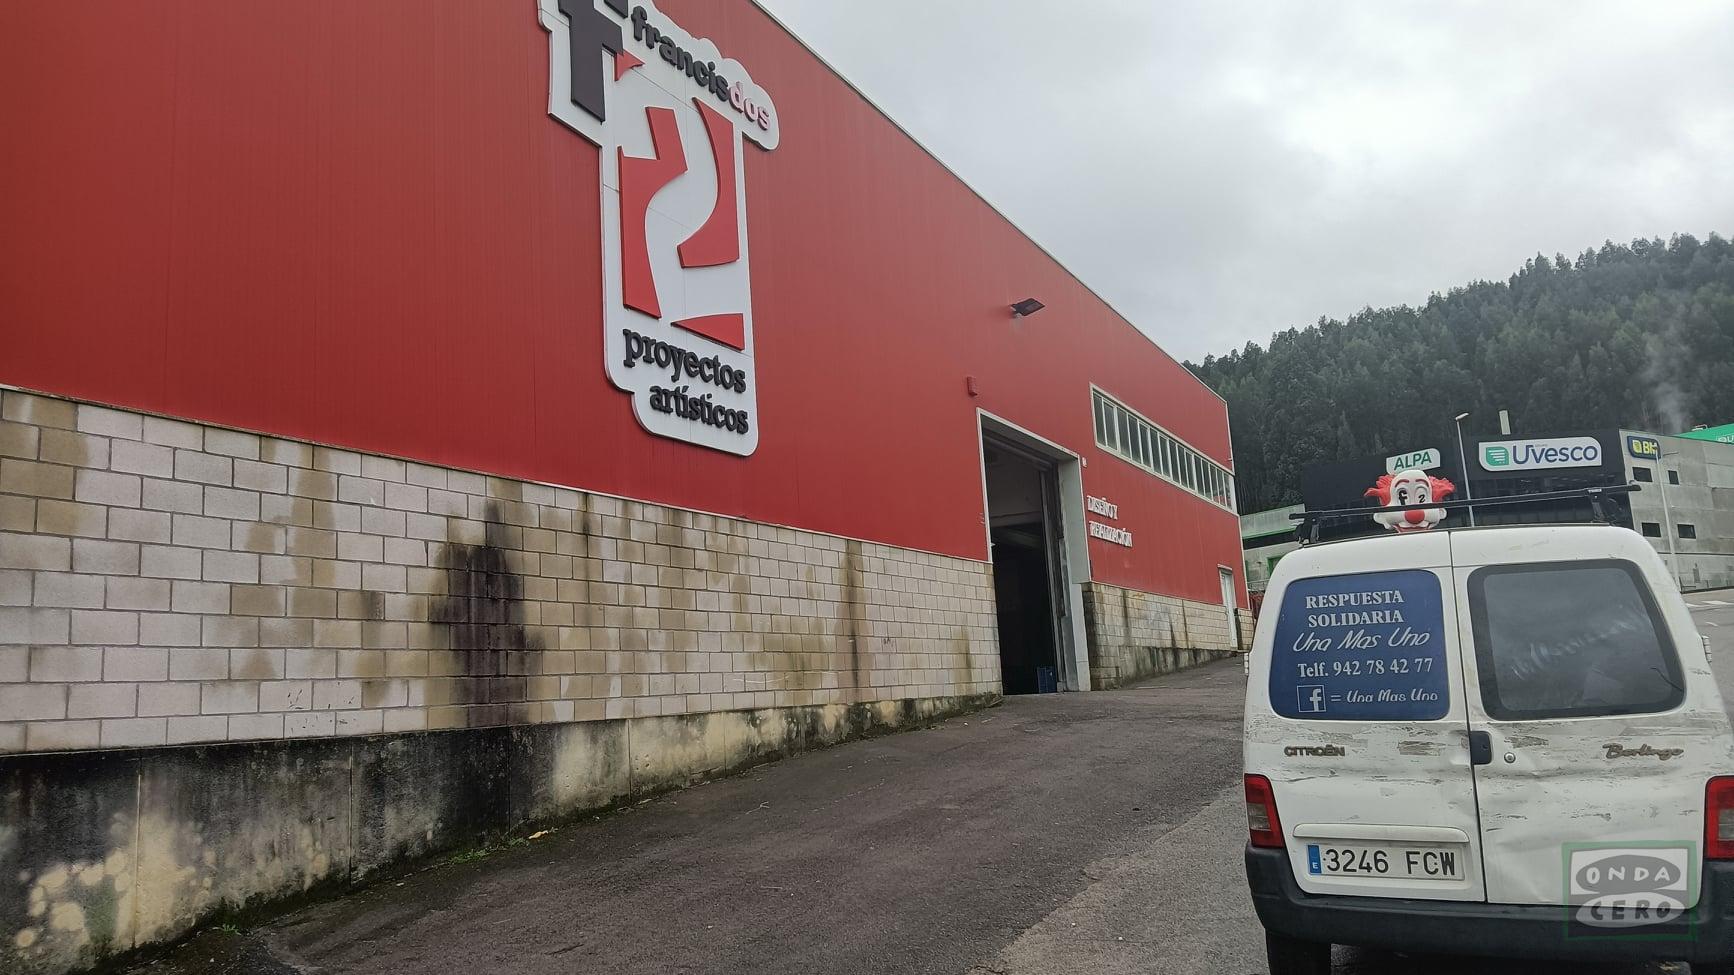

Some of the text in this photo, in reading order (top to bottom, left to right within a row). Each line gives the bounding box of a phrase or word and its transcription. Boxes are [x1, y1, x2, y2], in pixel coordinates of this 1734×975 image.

[630, 5, 772, 131] francisdos
[622, 328, 747, 394] proyectos
[649, 385, 749, 435] artísticos
[1393, 451, 1432, 471] ALPA
[1512, 444, 1598, 465] Uvesco
[1305, 590, 1404, 609] RESPUESTA
[1308, 610, 1404, 628] SOLIDARIA
[1292, 626, 1431, 652] Una Mas Uno
[1298, 658, 1433, 678] Telf. 942 78 42 77
[1346, 690, 1374, 703] Una
[1377, 689, 1407, 702] Mas
[1410, 688, 1438, 701] Uno
[1602, 743, 1684, 761] Berlingo
[1312, 862, 1319, 870] E
[1324, 848, 1455, 876] 3246 FCW
